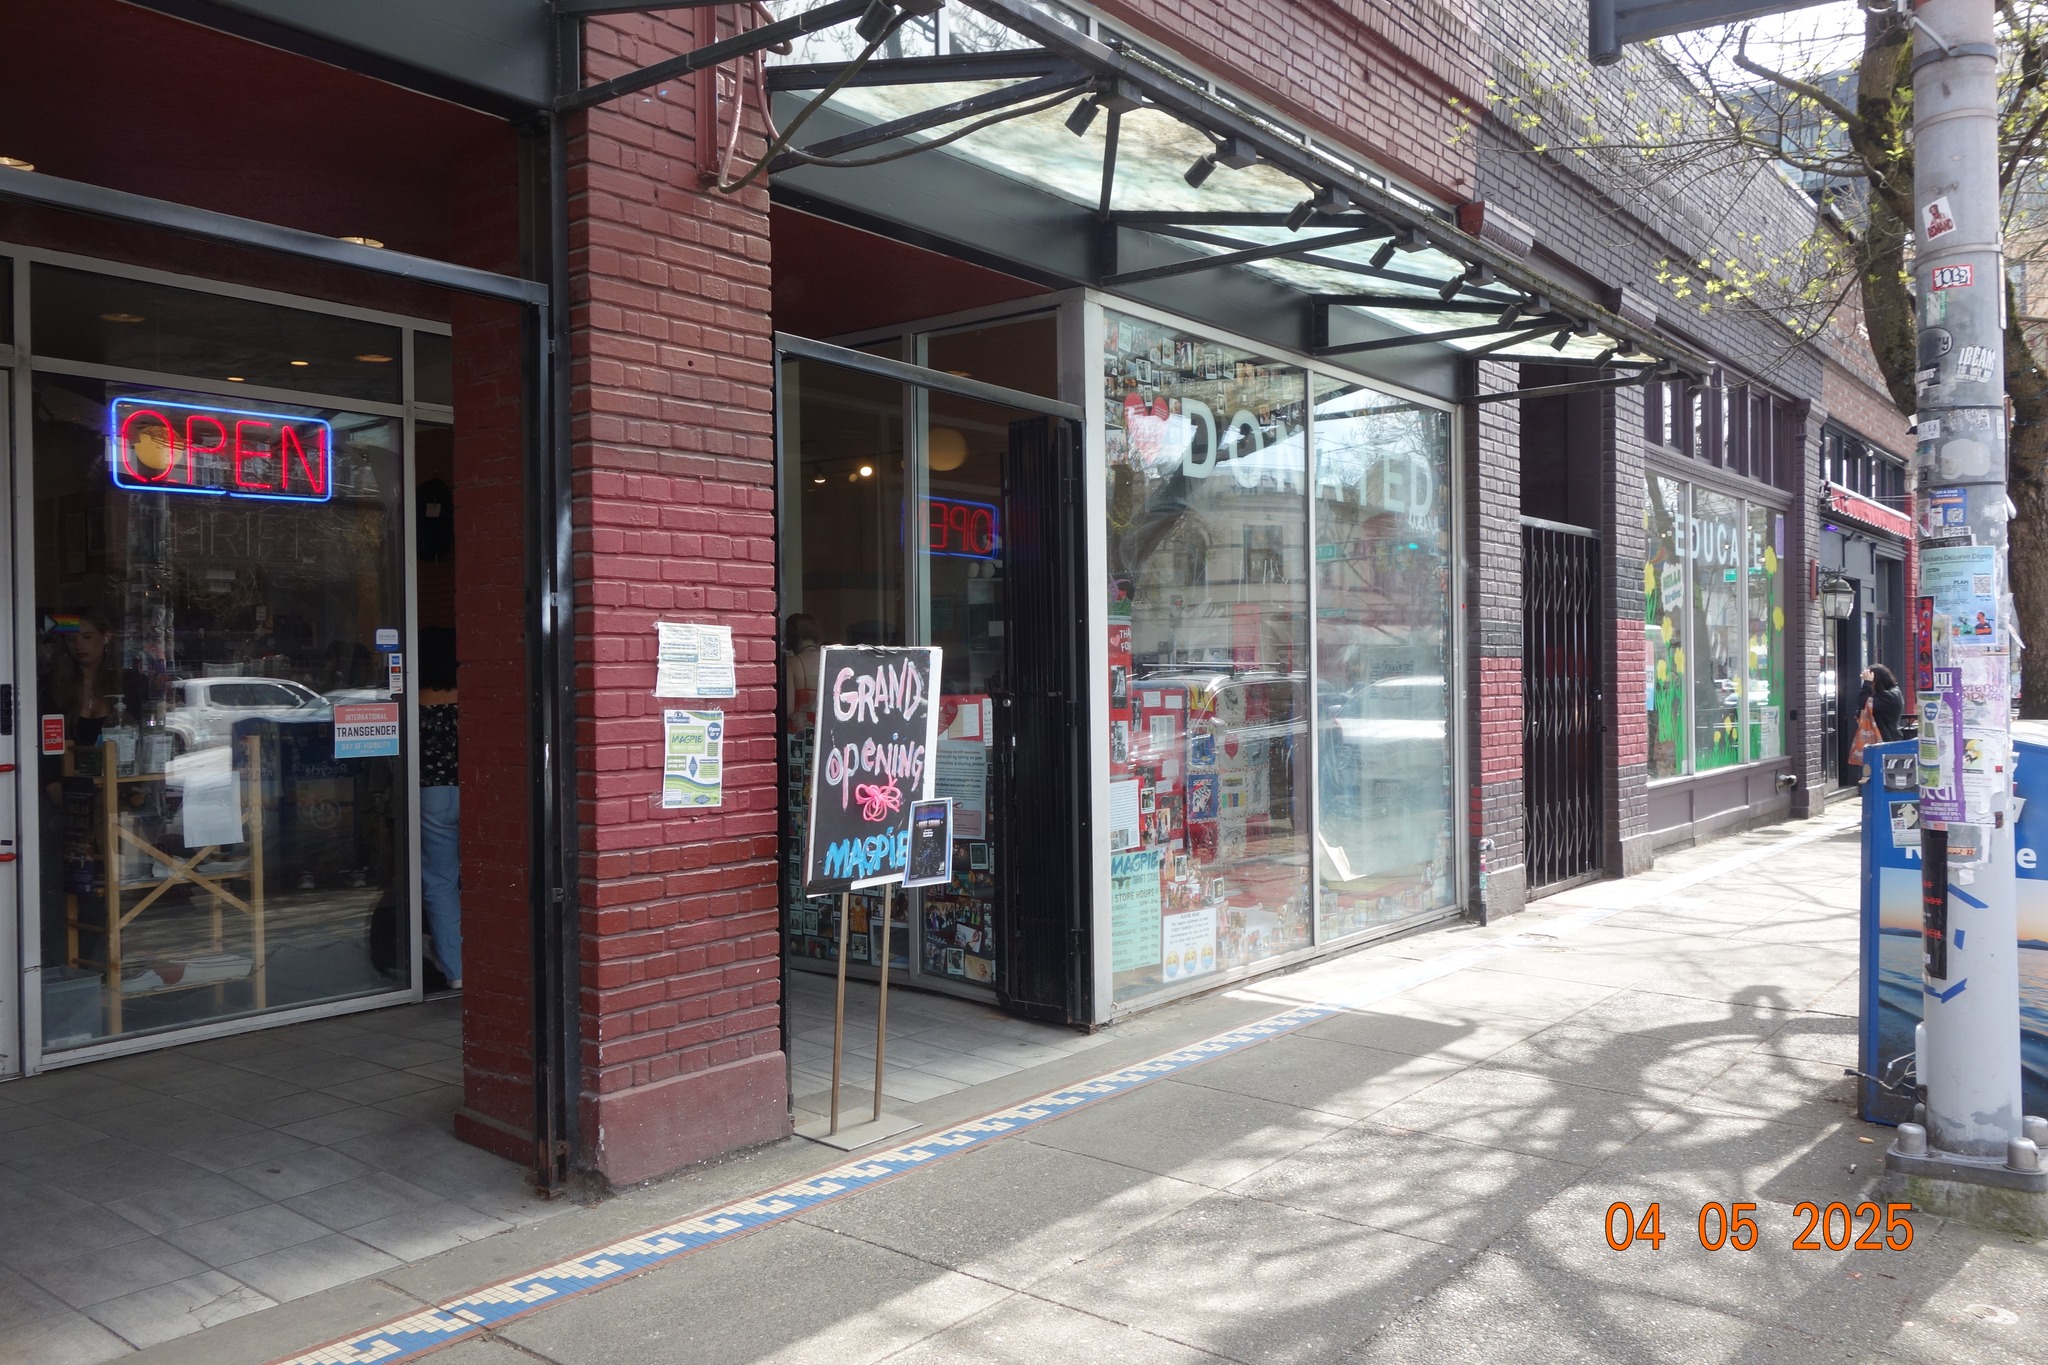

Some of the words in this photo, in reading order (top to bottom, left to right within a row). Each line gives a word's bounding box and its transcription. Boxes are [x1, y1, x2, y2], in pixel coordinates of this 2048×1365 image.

[122, 410, 325, 493] OPEN
[833, 657, 923, 723] GRAND
[345, 713, 388, 721] INTERNATIONAL
[337, 725, 397, 738] TRANSGENDER
[355, 742, 361, 750] OF
[364, 741, 390, 749] VISIBILITY
[672, 735, 703, 744] MAGPIE
[1111, 850, 1159, 876] MAGPIE
[1115, 892, 1134, 903] STORE
[1136, 888, 1155, 899] HOURS
